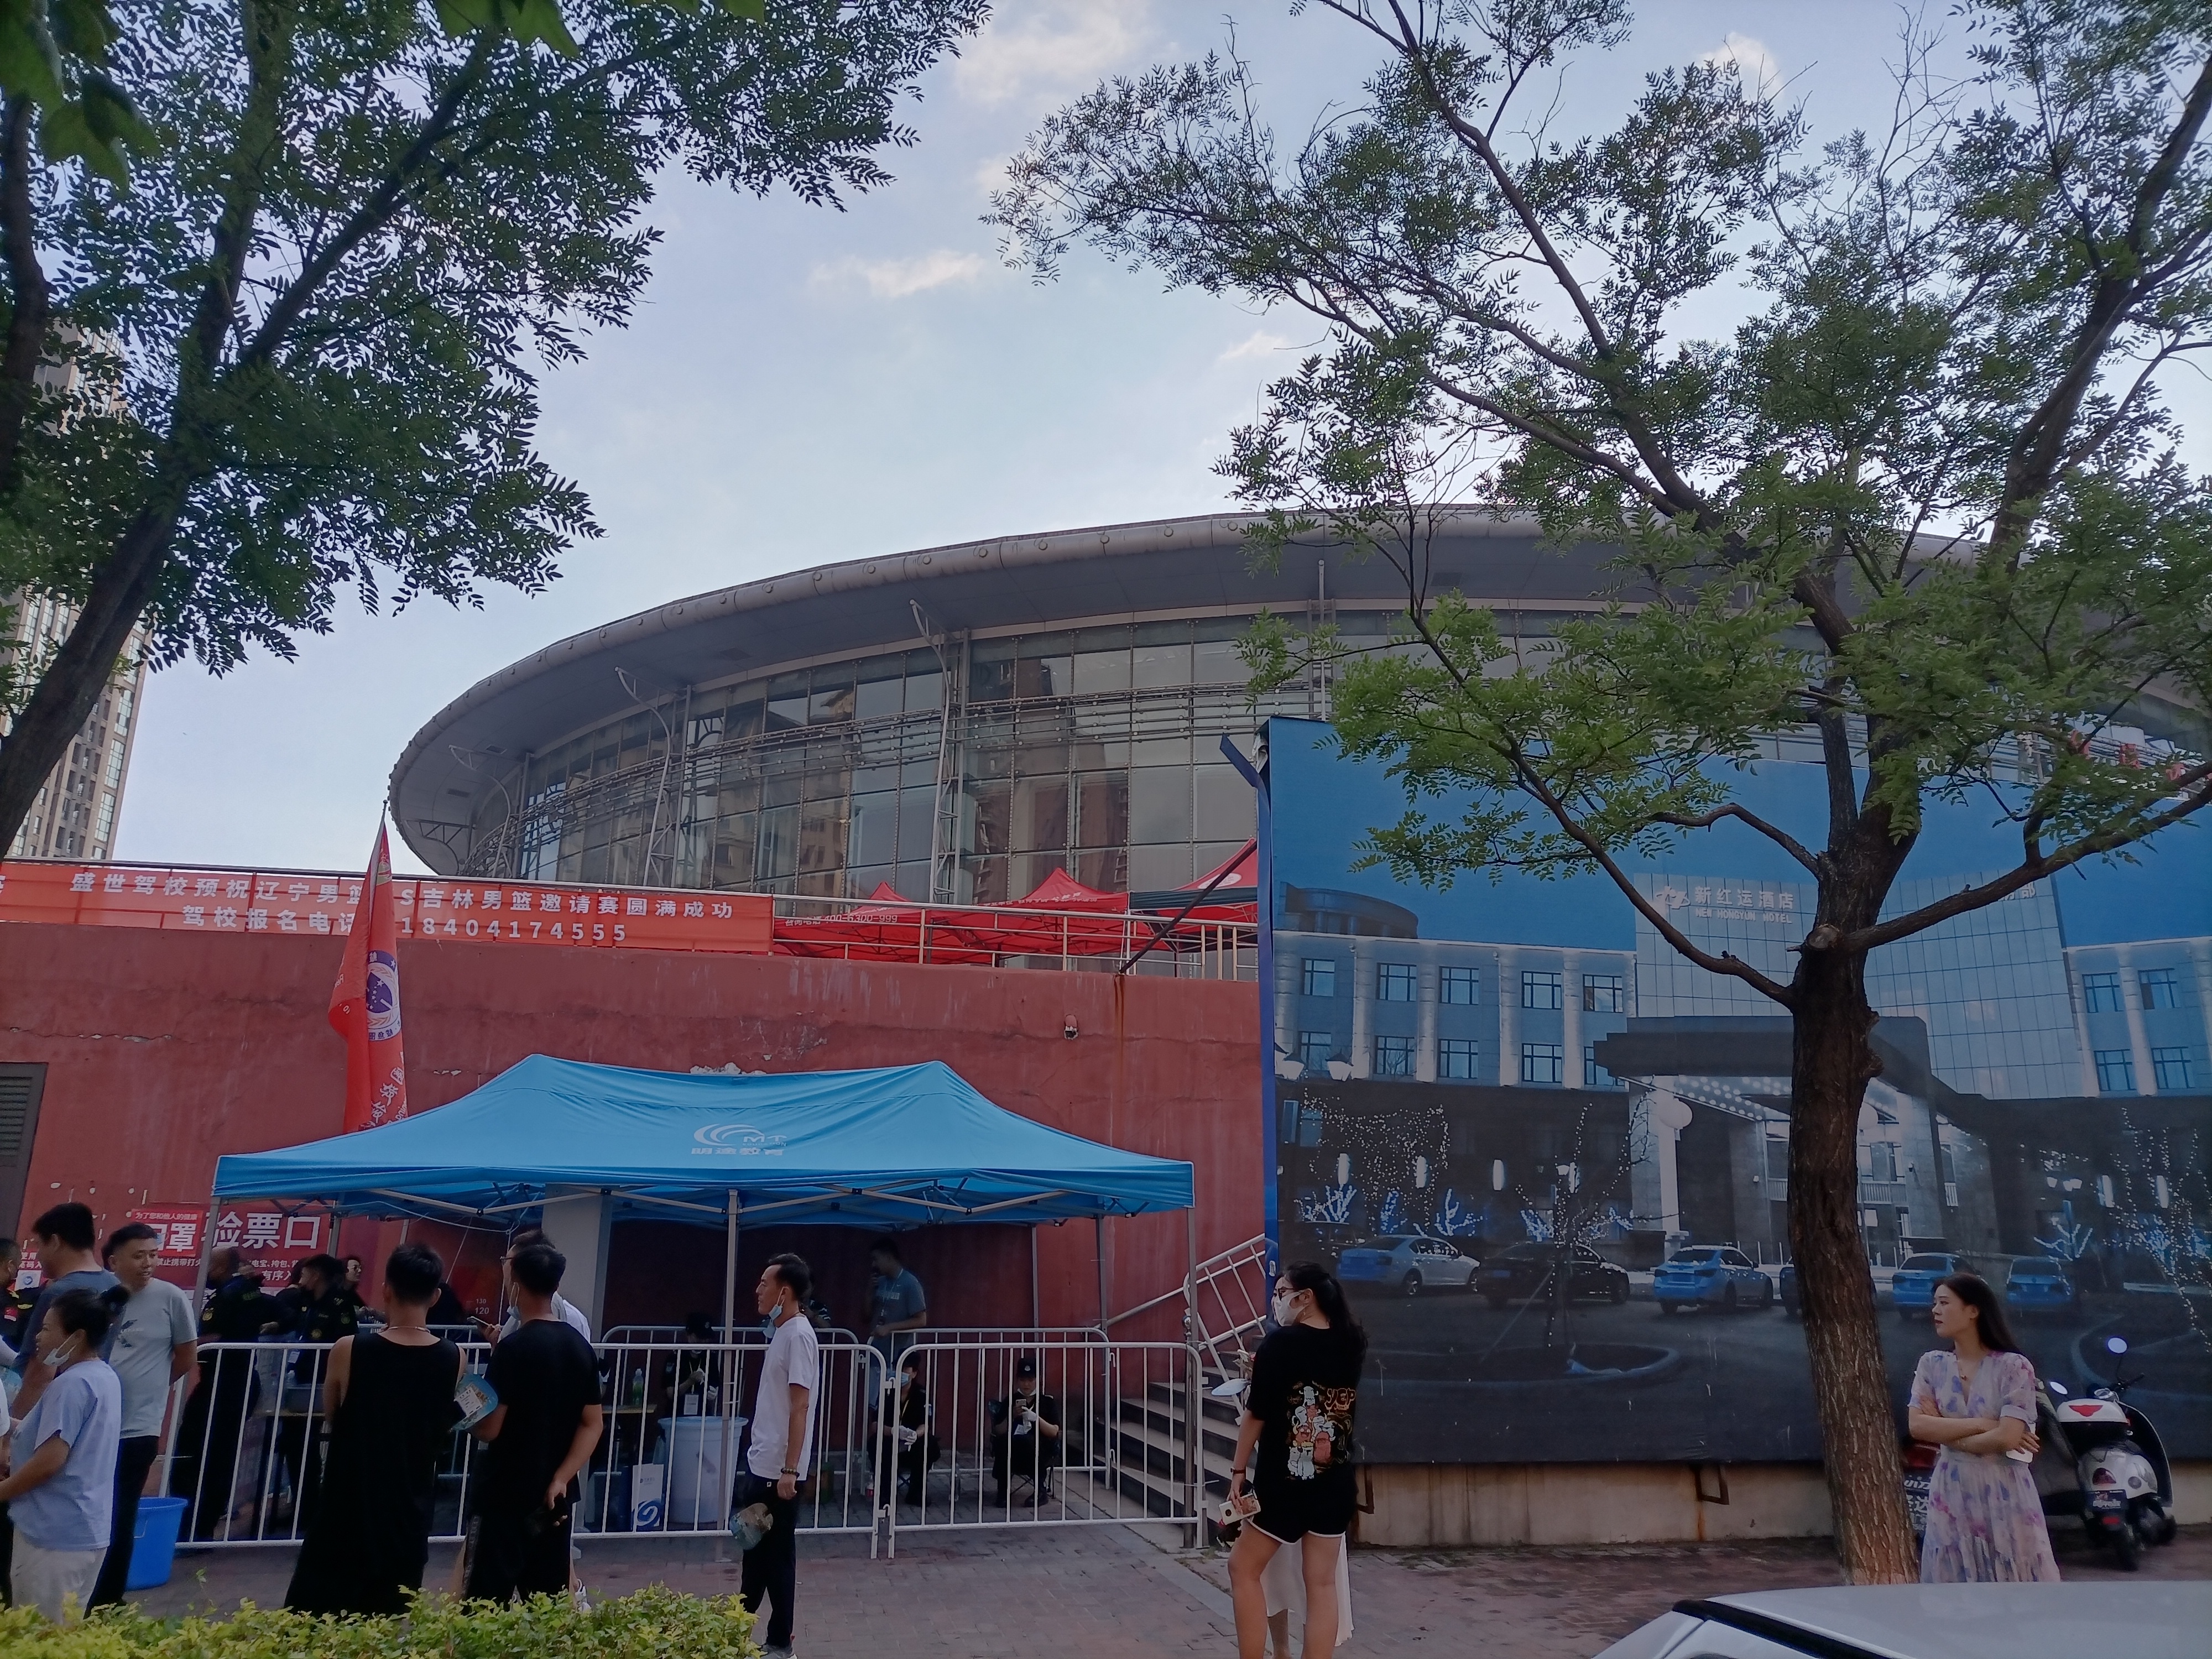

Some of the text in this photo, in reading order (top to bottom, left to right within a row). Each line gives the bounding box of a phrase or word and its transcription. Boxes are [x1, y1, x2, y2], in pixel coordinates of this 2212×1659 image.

[1694, 886, 1793, 910] 新红运酒店
[1695, 907, 1793, 924] NEW HONGYUN HOTEL
[401, 917, 625, 941] 18404174555
[135, 1212, 198, 1220] 为了您和他人的健康
